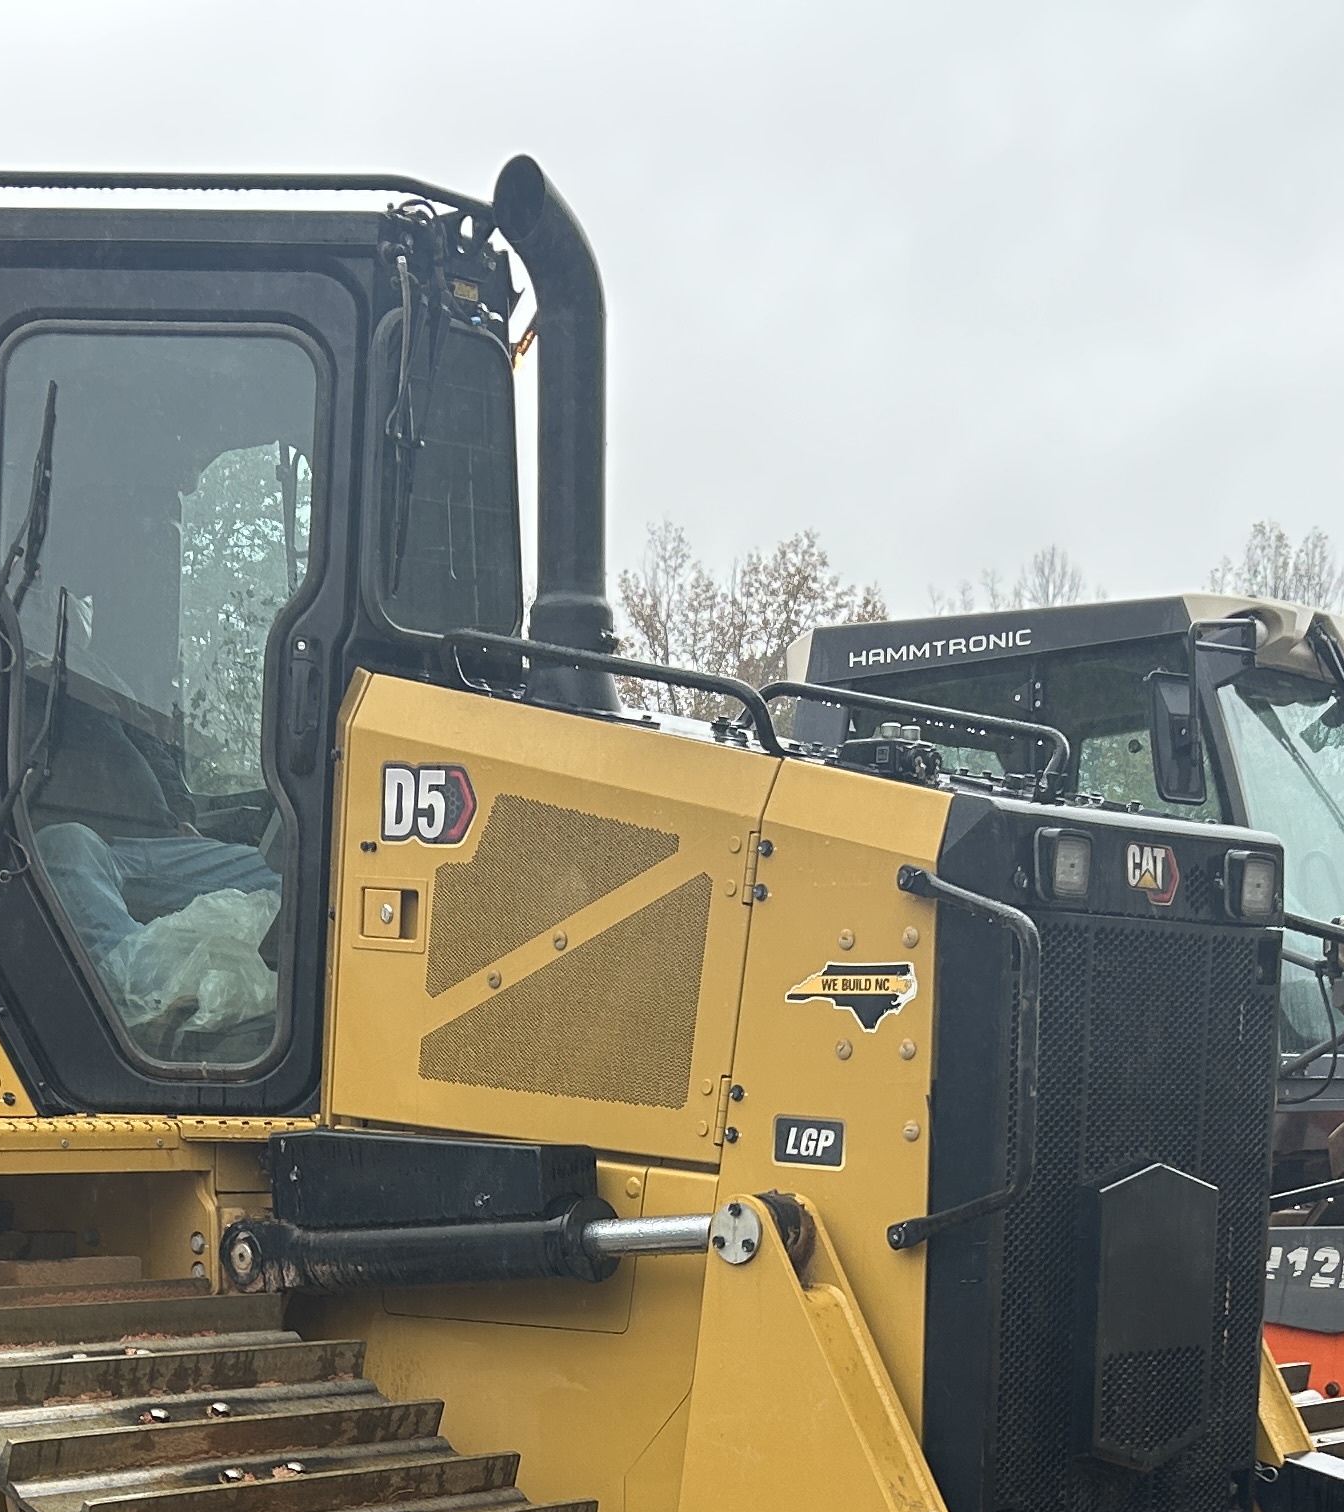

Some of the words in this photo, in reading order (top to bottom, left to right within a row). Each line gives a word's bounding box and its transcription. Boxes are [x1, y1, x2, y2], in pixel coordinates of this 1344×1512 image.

[848, 628, 1032, 668] HAMMTRONIC
[384, 768, 446, 839] D5
[1127, 844, 1166, 889] CAT
[821, 979, 839, 991] WE
[841, 979, 872, 991] BUILD
[875, 978, 890, 991] NC
[785, 1126, 835, 1157] LGP
